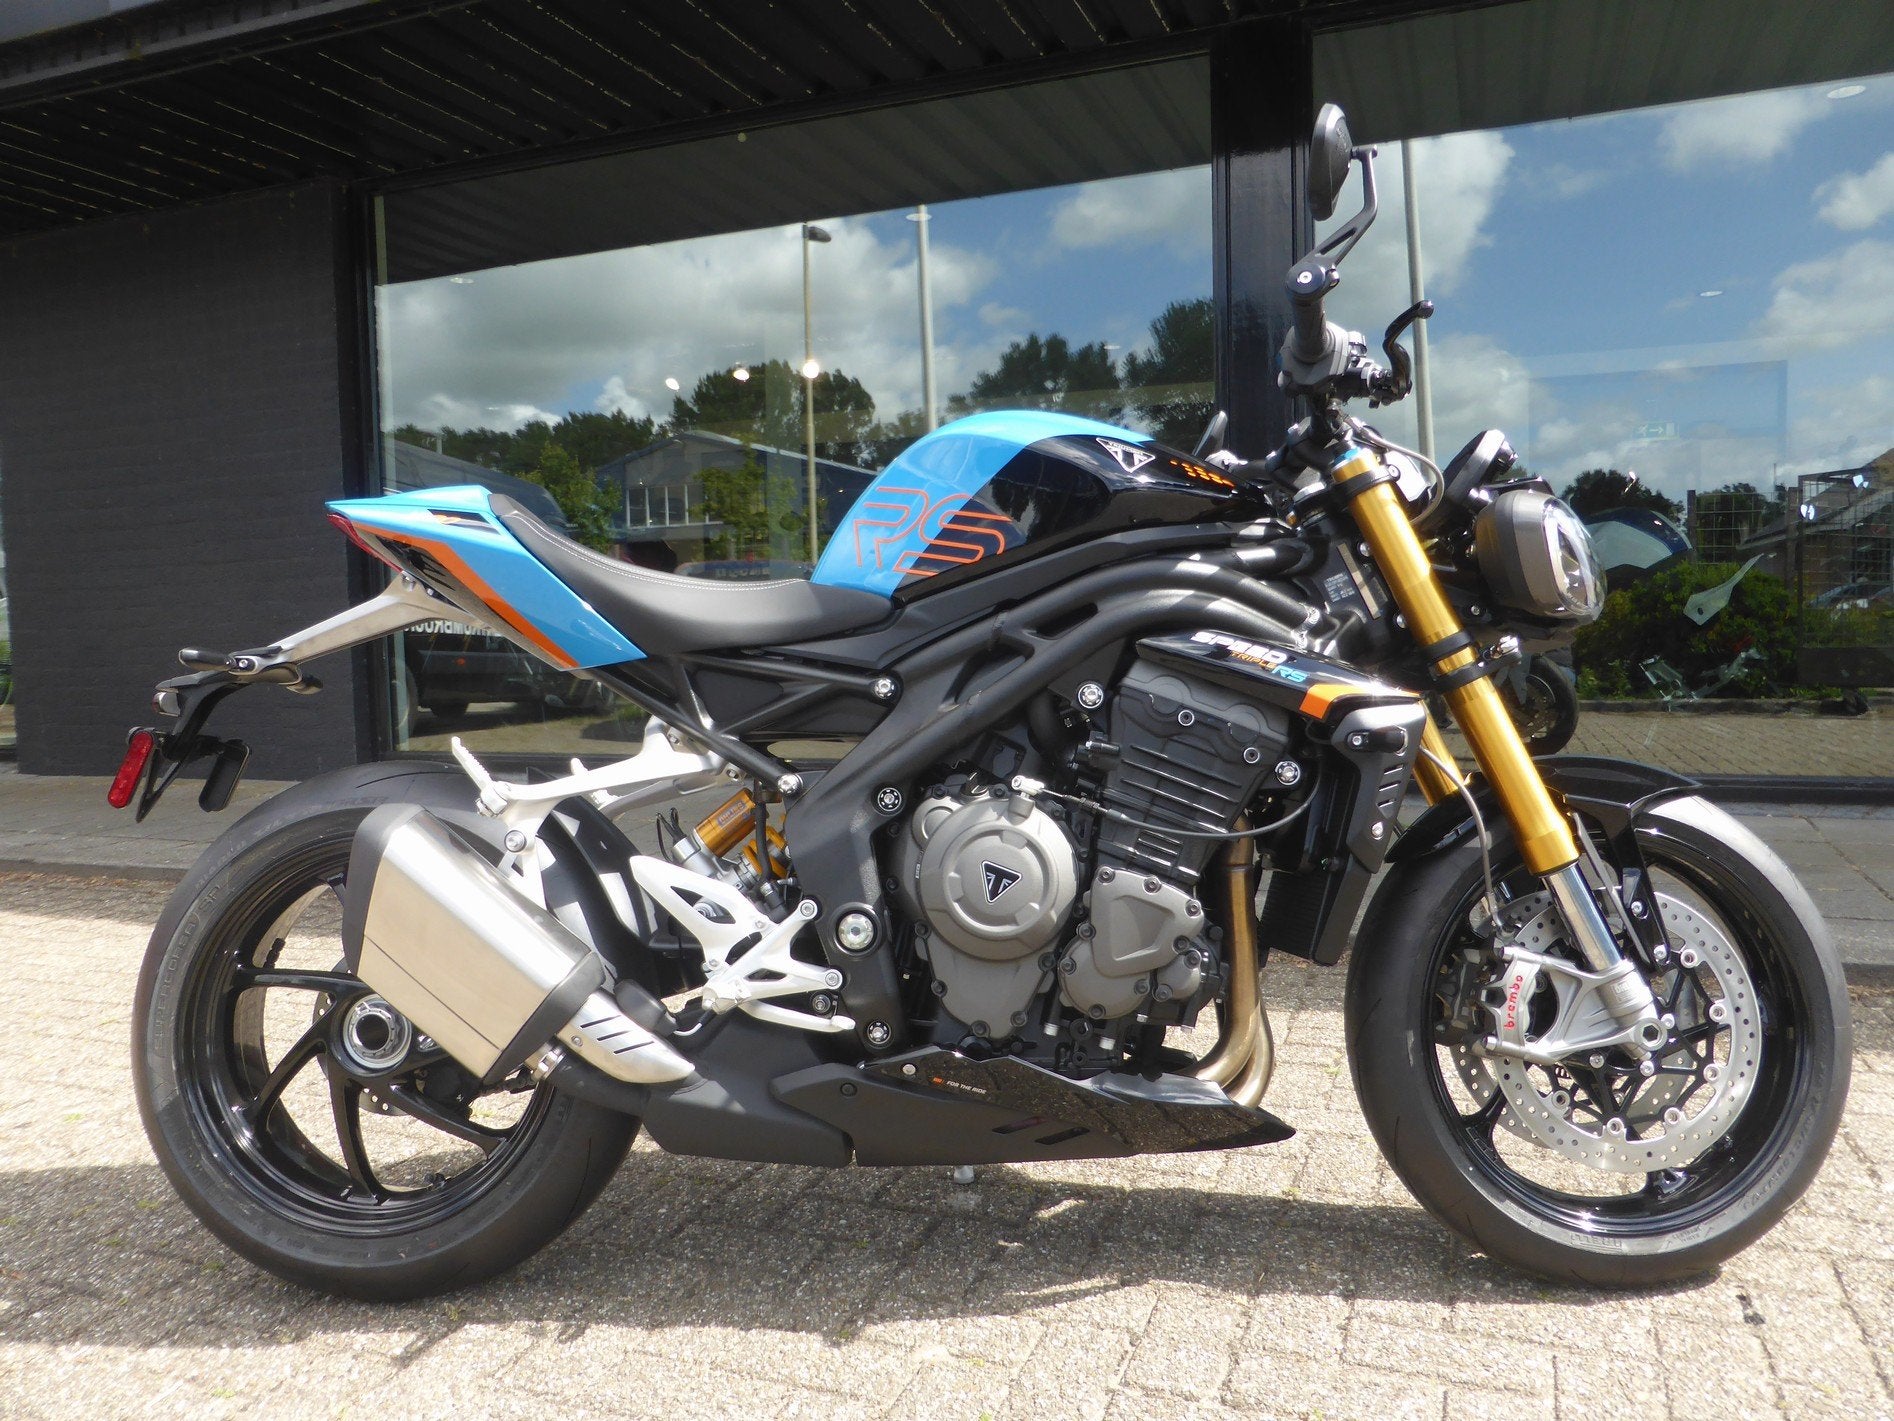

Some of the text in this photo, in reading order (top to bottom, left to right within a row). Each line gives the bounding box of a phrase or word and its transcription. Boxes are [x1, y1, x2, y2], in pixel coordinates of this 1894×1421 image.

[853, 486, 1013, 576] RS
[1190, 631, 1287, 664] SPEED
[1230, 650, 1278, 669] TRIPLE
[1272, 664, 1308, 683] RS
[1503, 974, 1524, 1031] brembo
[946, 1080, 987, 1095] FOR THE RIDE
